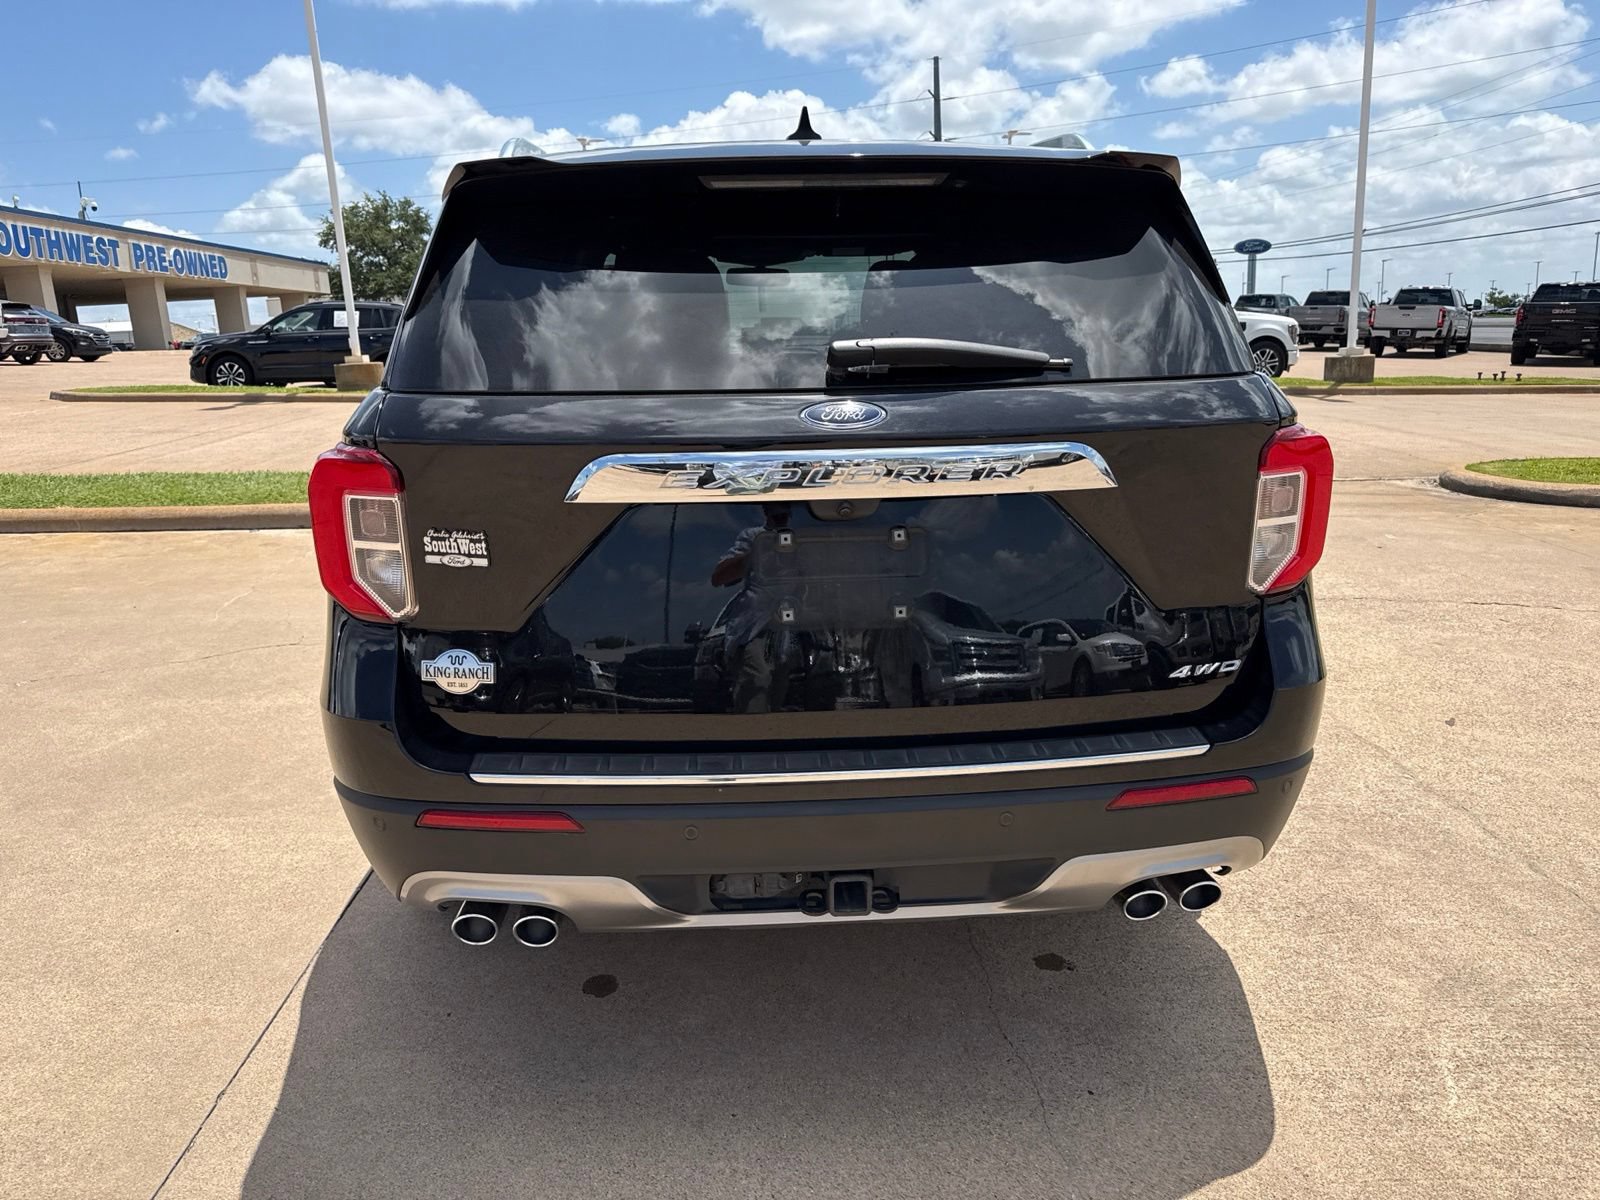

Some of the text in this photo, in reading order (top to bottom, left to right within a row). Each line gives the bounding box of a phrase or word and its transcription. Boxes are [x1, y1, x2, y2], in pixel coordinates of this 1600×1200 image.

[131, 241, 229, 281] PRE-OWNED
[821, 404, 866, 420] Ford
[659, 460, 1023, 489] EXPLORER
[447, 556, 466, 565] Ford
[425, 664, 489, 680] KING RANCH
[1168, 659, 1242, 678] 4WD
